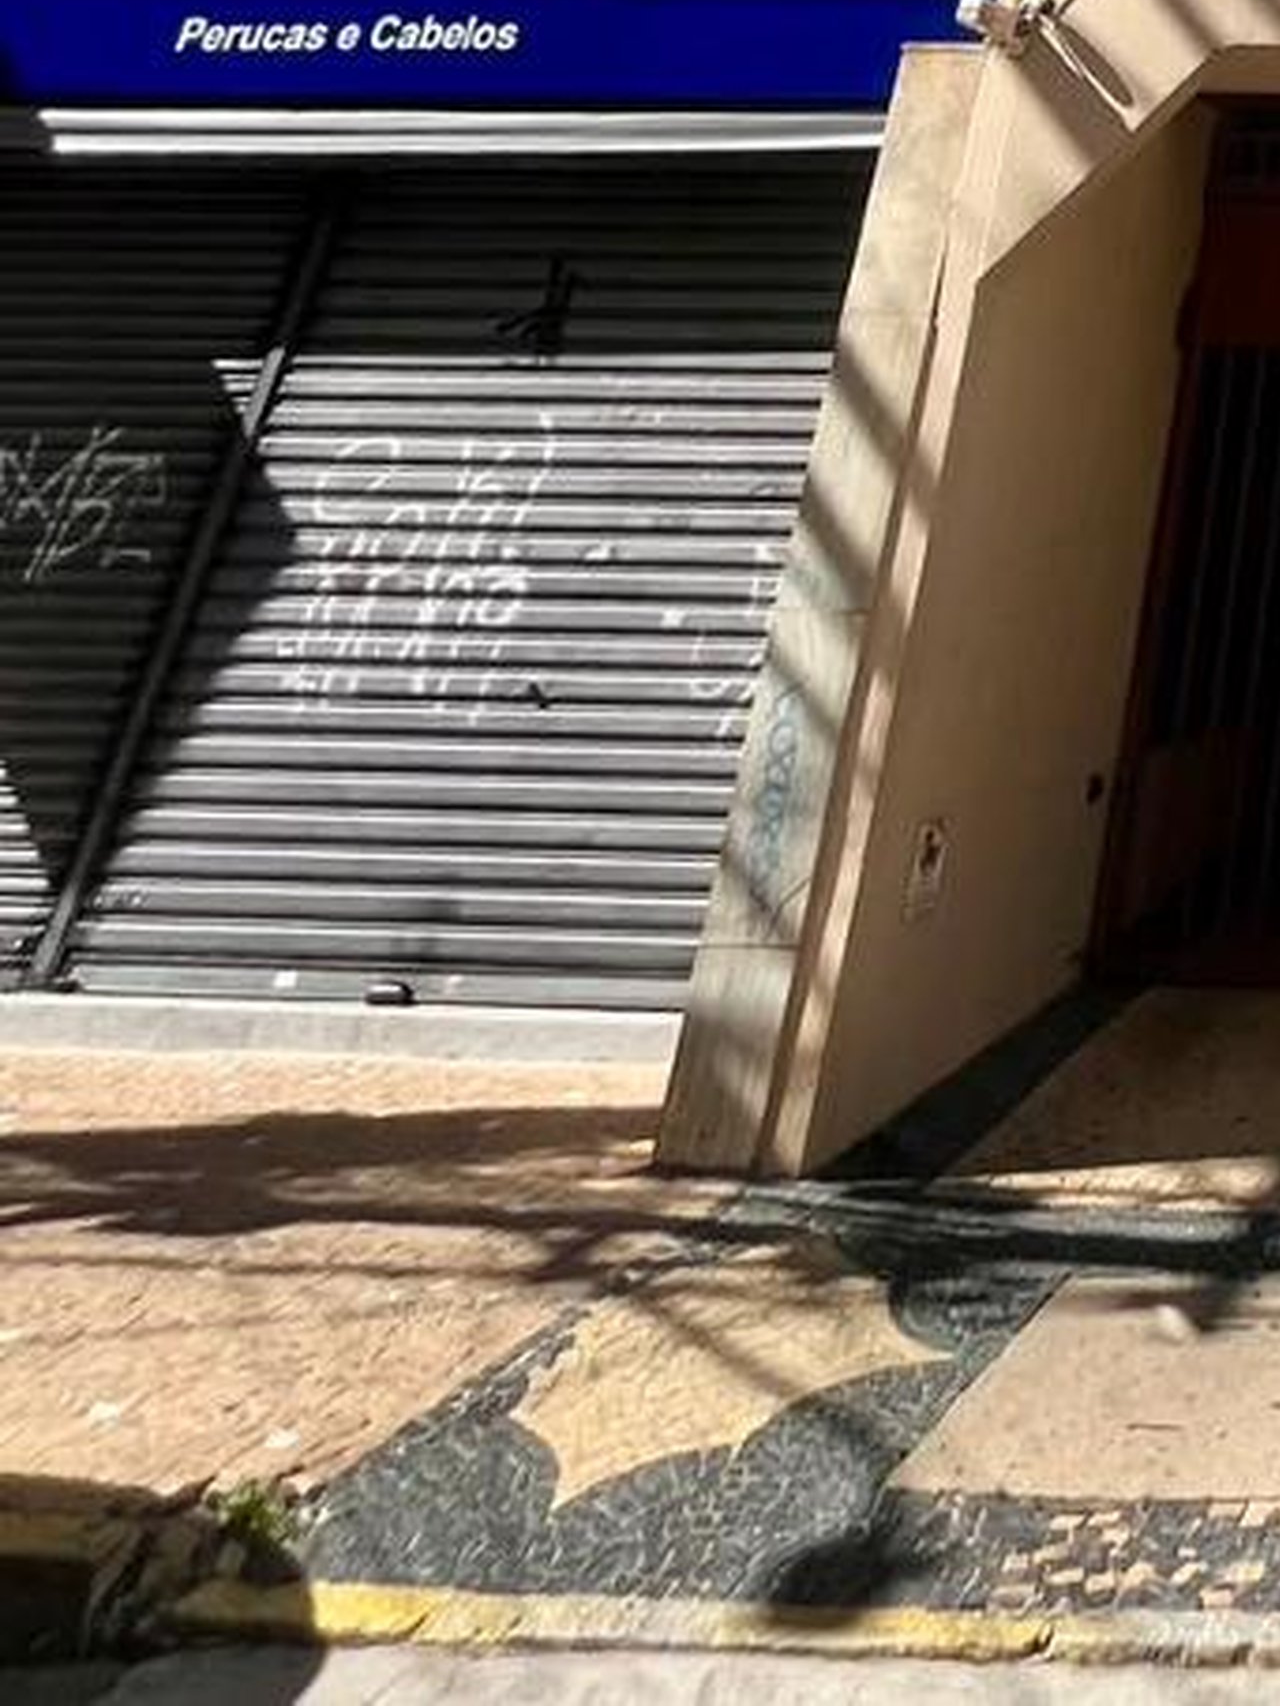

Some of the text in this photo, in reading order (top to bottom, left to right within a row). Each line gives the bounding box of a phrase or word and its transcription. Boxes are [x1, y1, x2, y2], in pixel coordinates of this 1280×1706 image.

[174, 14, 520, 52] Perucas e Cabelos
